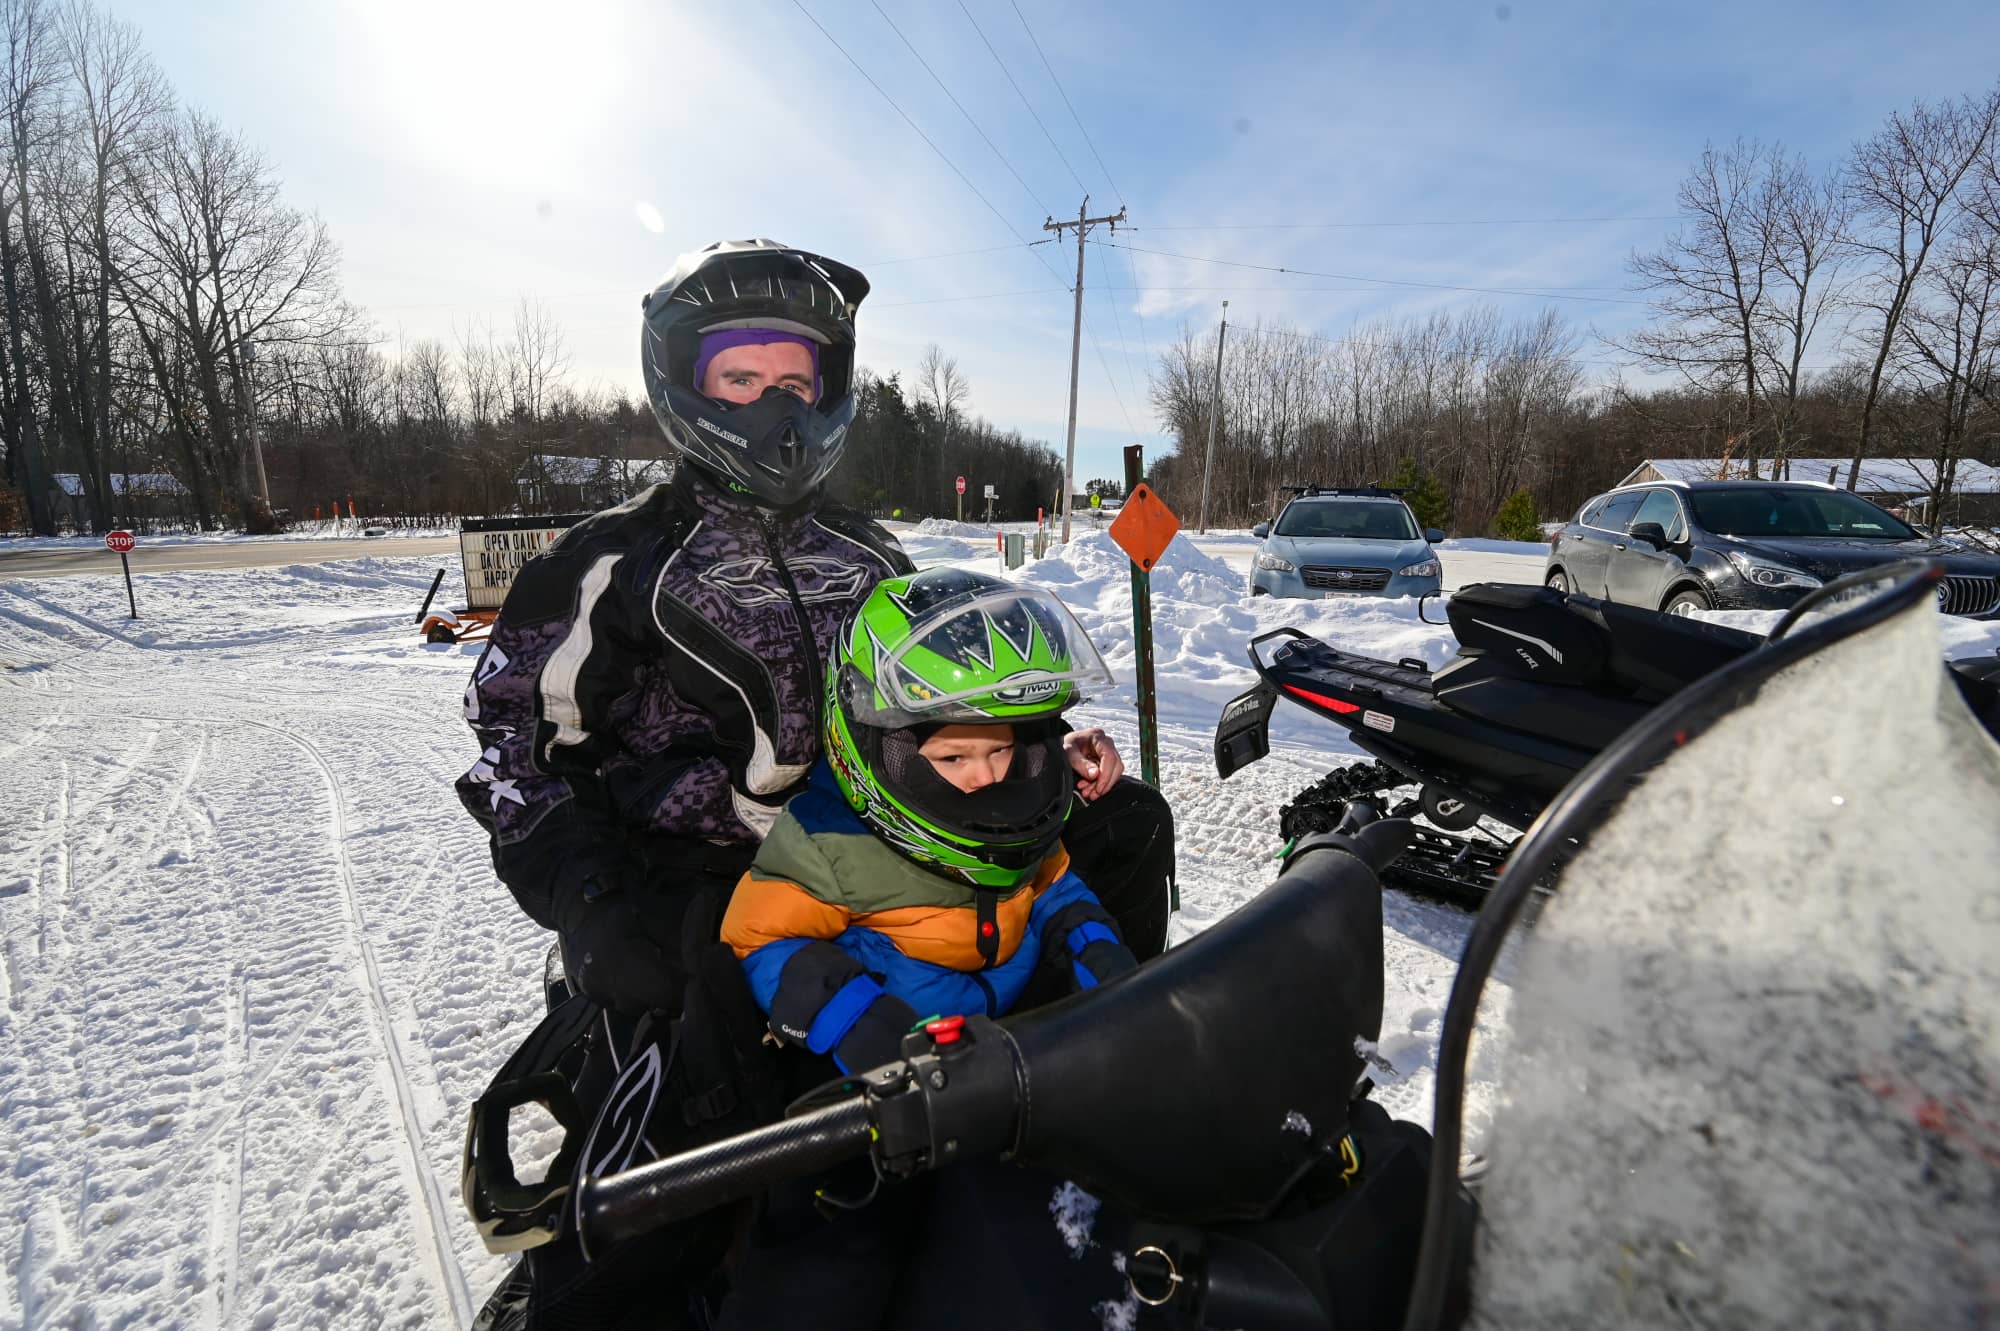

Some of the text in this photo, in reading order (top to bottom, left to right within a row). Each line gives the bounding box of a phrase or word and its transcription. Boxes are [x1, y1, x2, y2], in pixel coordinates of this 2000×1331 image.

[107, 537, 134, 546] STOP
[484, 533, 510, 551] OPEN
[513, 532, 542, 551] DAILY
[480, 551, 507, 570] DAILY
